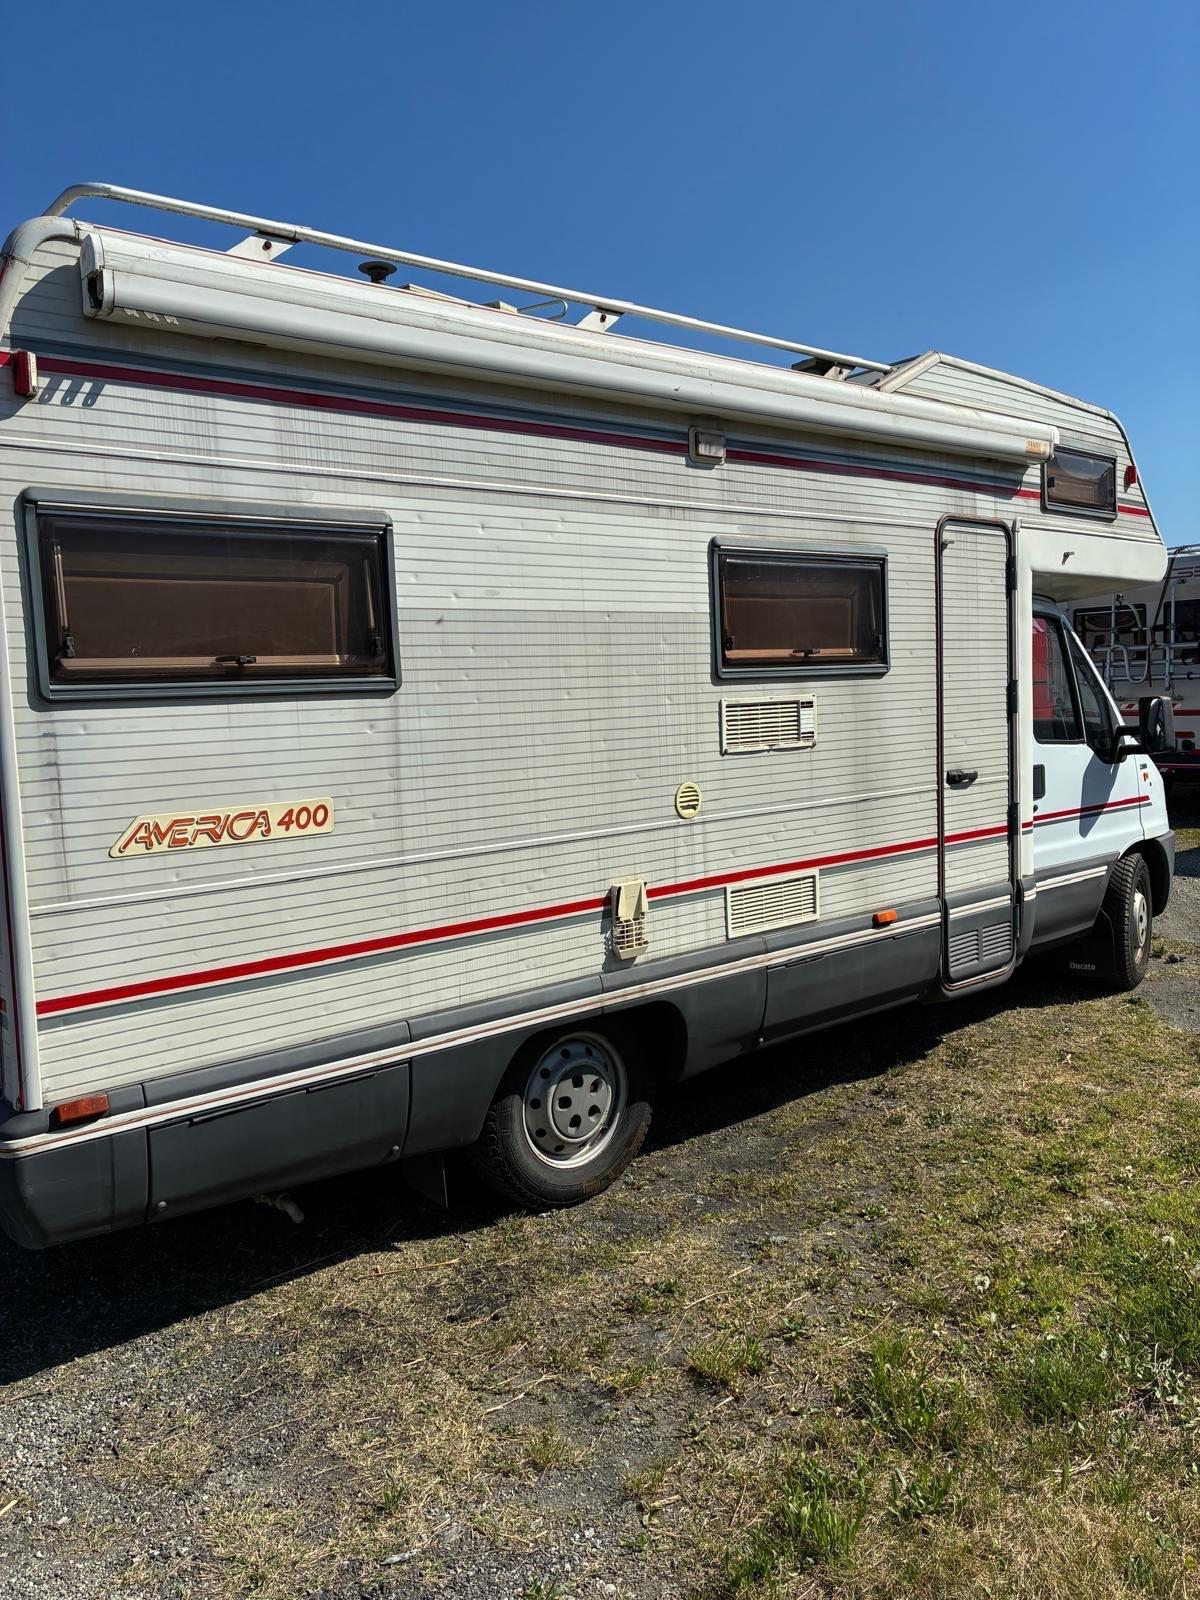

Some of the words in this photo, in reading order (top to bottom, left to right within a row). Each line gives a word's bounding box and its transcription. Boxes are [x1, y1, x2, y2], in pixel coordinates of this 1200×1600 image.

[118, 810, 272, 853] AMERICA
[277, 804, 329, 831] 400
[1069, 961, 1096, 971] Ducato
